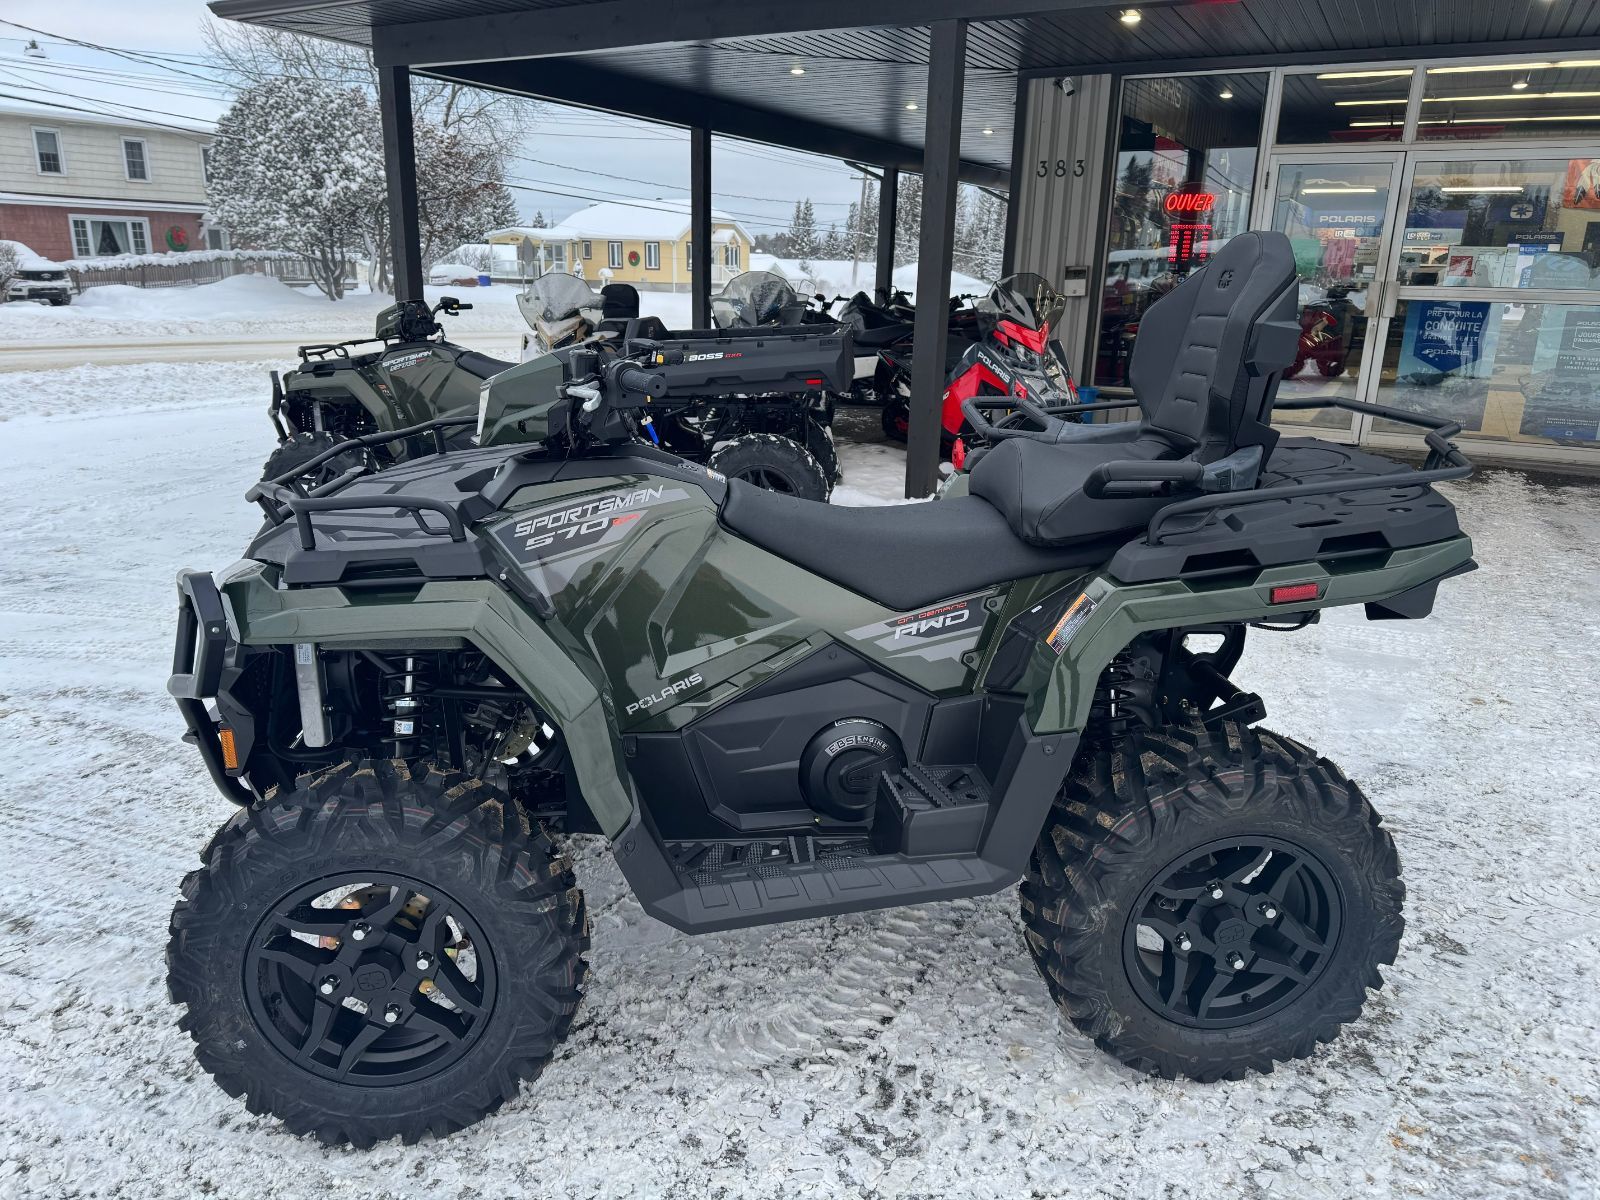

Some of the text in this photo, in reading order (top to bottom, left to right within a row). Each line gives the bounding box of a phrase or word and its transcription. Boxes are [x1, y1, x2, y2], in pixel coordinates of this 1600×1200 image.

[1036, 159, 1085, 178] 383
[1320, 215, 1376, 223] POLARIS
[1471, 311, 1483, 319] LA
[1424, 320, 1481, 333] CONDUITE
[382, 350, 433, 368] SPORTSMAN
[688, 352, 724, 362] BOSS
[1426, 348, 1470, 356] POLARIS
[977, 350, 1011, 383] POLARIS
[513, 484, 664, 538] SPORTSMAN
[524, 516, 610, 551] 570
[918, 601, 968, 619] DEMAND
[894, 609, 970, 640] AWD
[625, 672, 703, 715] POLARIS
[828, 735, 889, 754] EBS ENGINE
